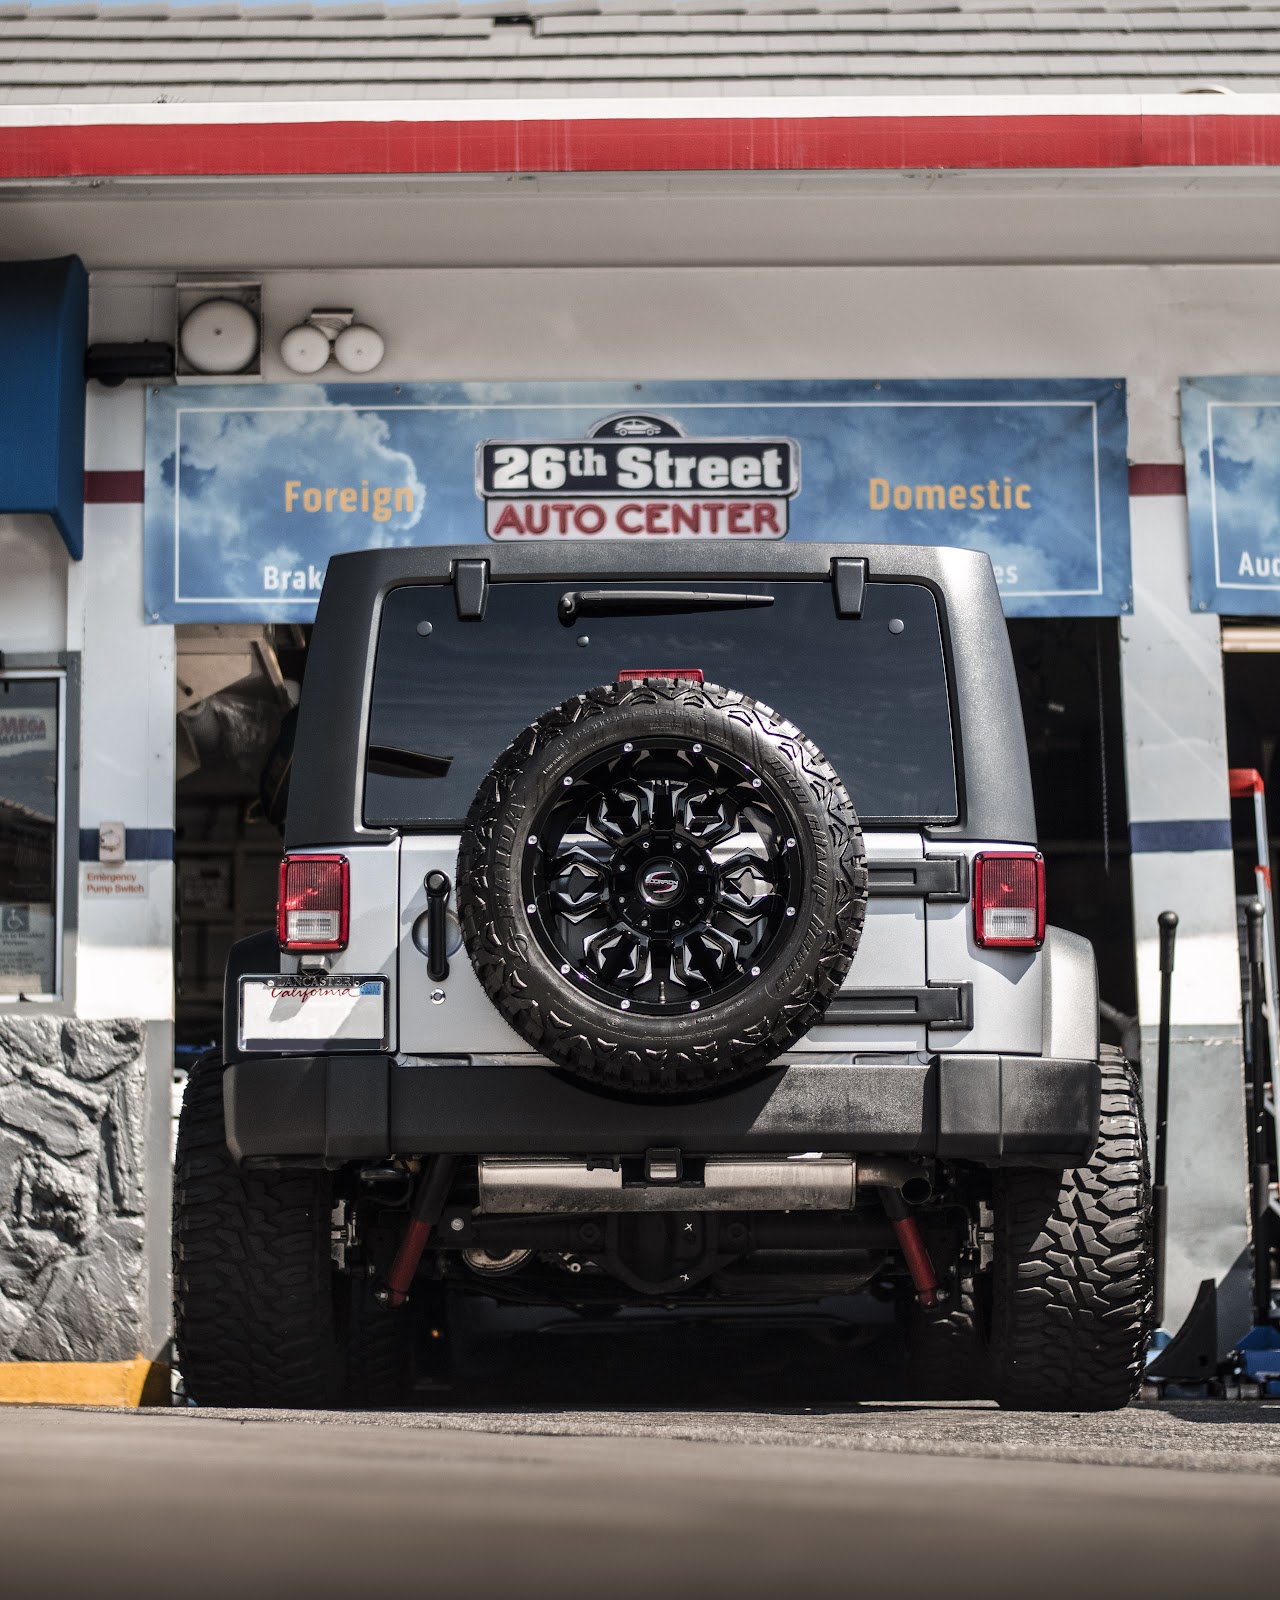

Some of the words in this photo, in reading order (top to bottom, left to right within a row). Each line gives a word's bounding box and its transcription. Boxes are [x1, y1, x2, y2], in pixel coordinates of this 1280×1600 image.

[493, 447, 607, 489] 26th
[617, 447, 782, 489] Street
[284, 480, 414, 522] Foreign
[868, 477, 1032, 510] Domestic
[493, 503, 607, 535] AUTO
[615, 503, 781, 535] CENTER
[264, 565, 325, 590] Brak
[87, 873, 137, 883] Emergency
[87, 884, 113, 895] Pump
[115, 884, 145, 894] Switch
[277, 976, 352, 987] LANCASTER
[271, 987, 361, 1003] California
